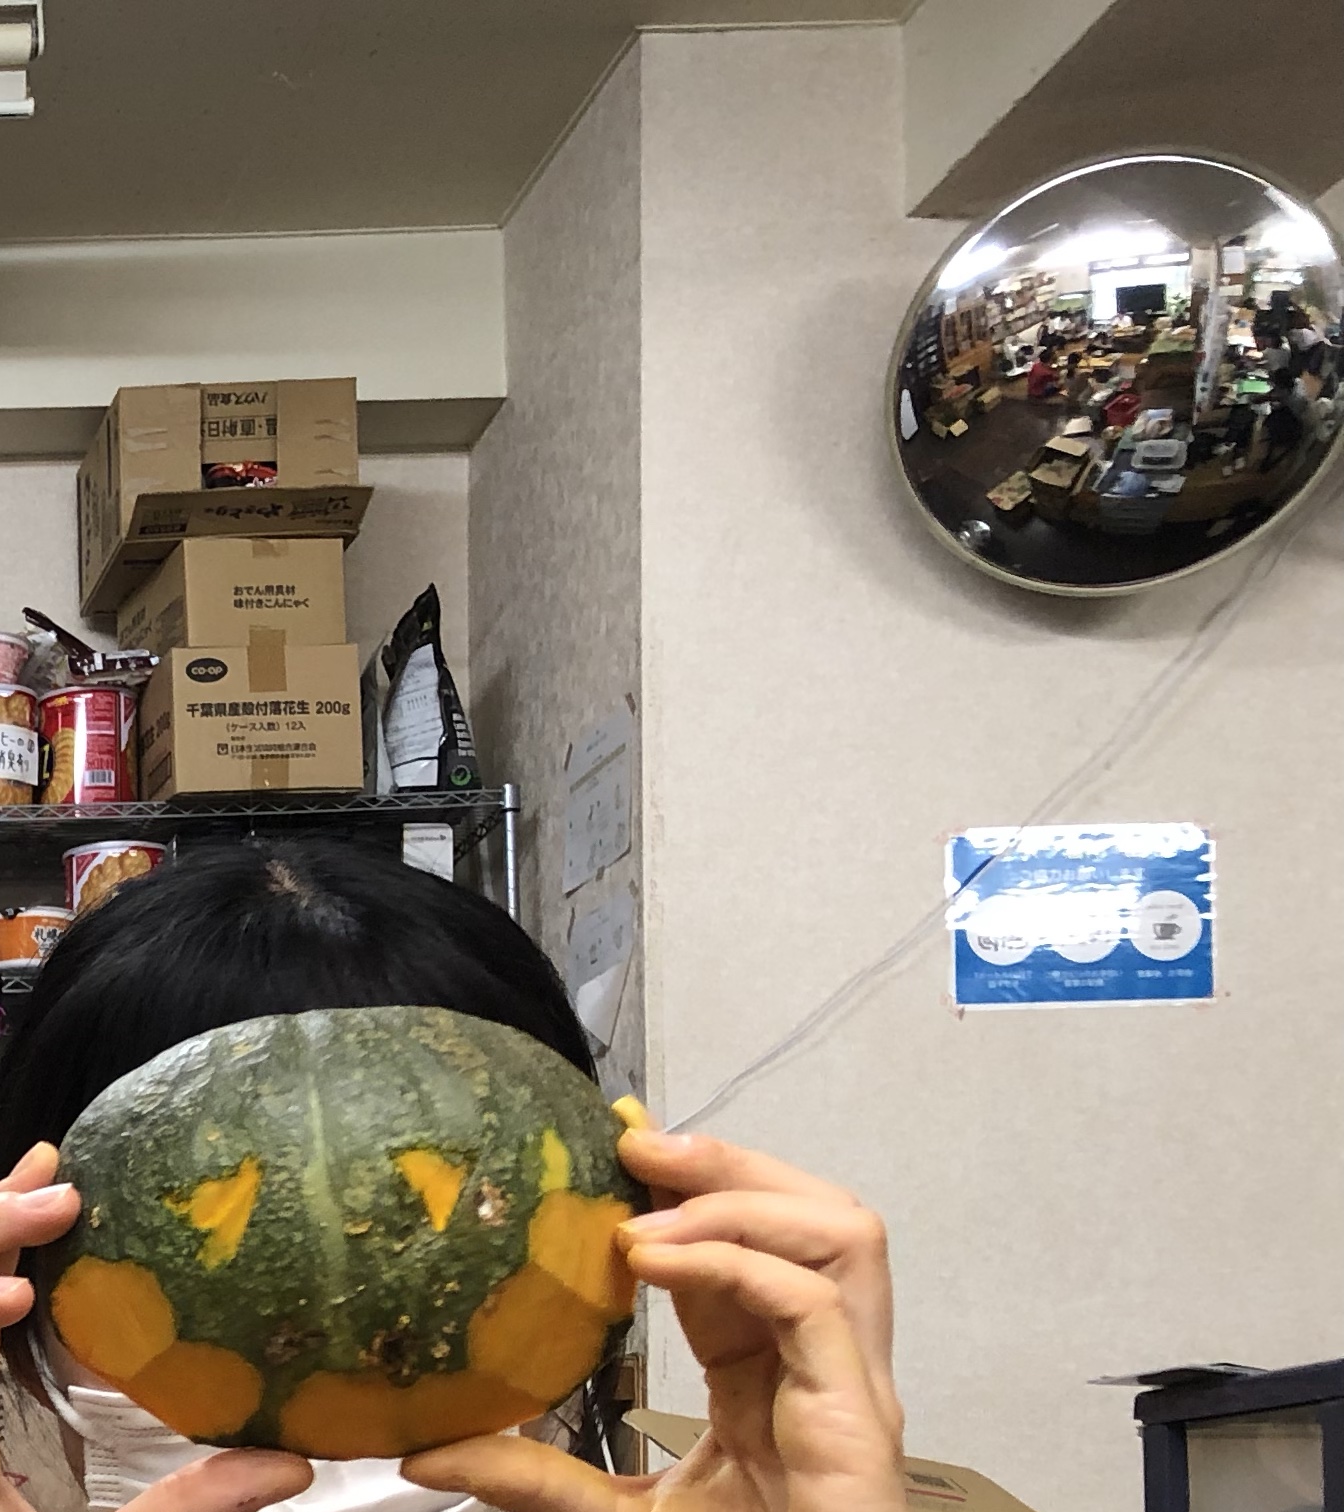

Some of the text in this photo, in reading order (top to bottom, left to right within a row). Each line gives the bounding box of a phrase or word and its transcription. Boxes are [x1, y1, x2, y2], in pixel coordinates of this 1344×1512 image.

[233, 597, 310, 610] 味付きこんにゃく
[315, 701, 351, 715] 200g
